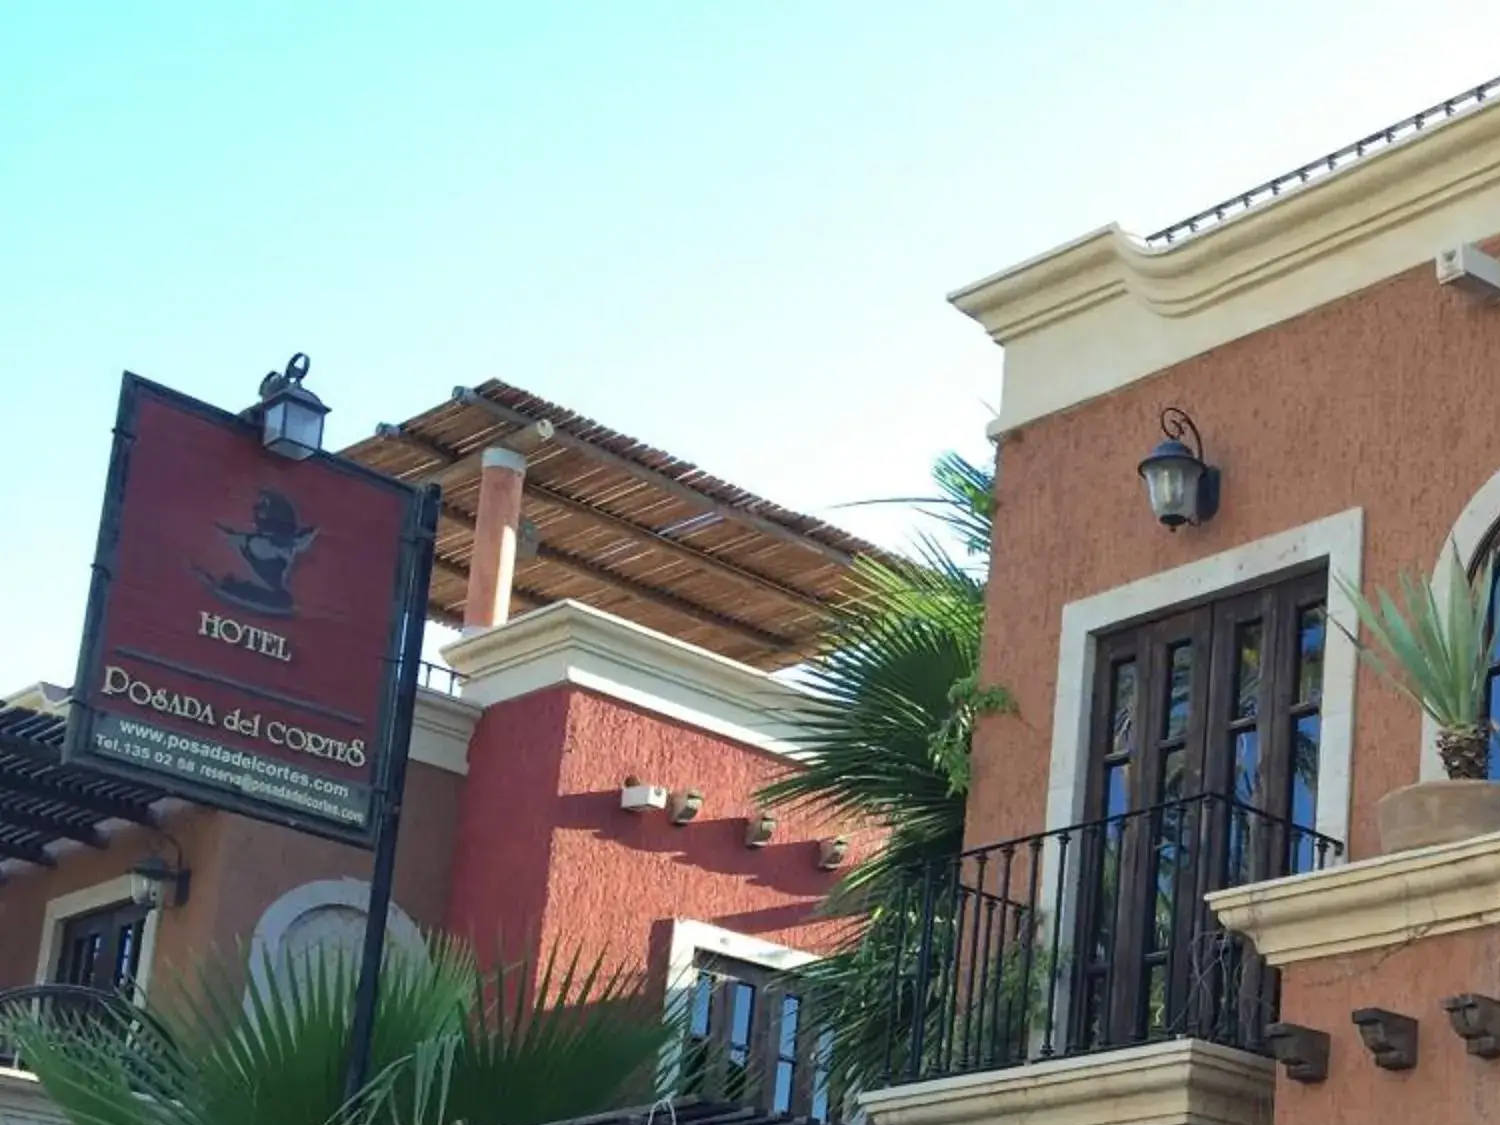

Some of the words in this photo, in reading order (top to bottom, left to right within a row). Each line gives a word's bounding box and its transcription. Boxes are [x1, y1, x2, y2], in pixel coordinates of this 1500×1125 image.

[198, 611, 291, 661] HOTEL
[101, 666, 216, 725] POSADA
[223, 708, 262, 737] del
[267, 721, 366, 767] CORTES
[119, 719, 349, 798] www.posadadelcortes.com
[154, 751, 172, 766] 02
